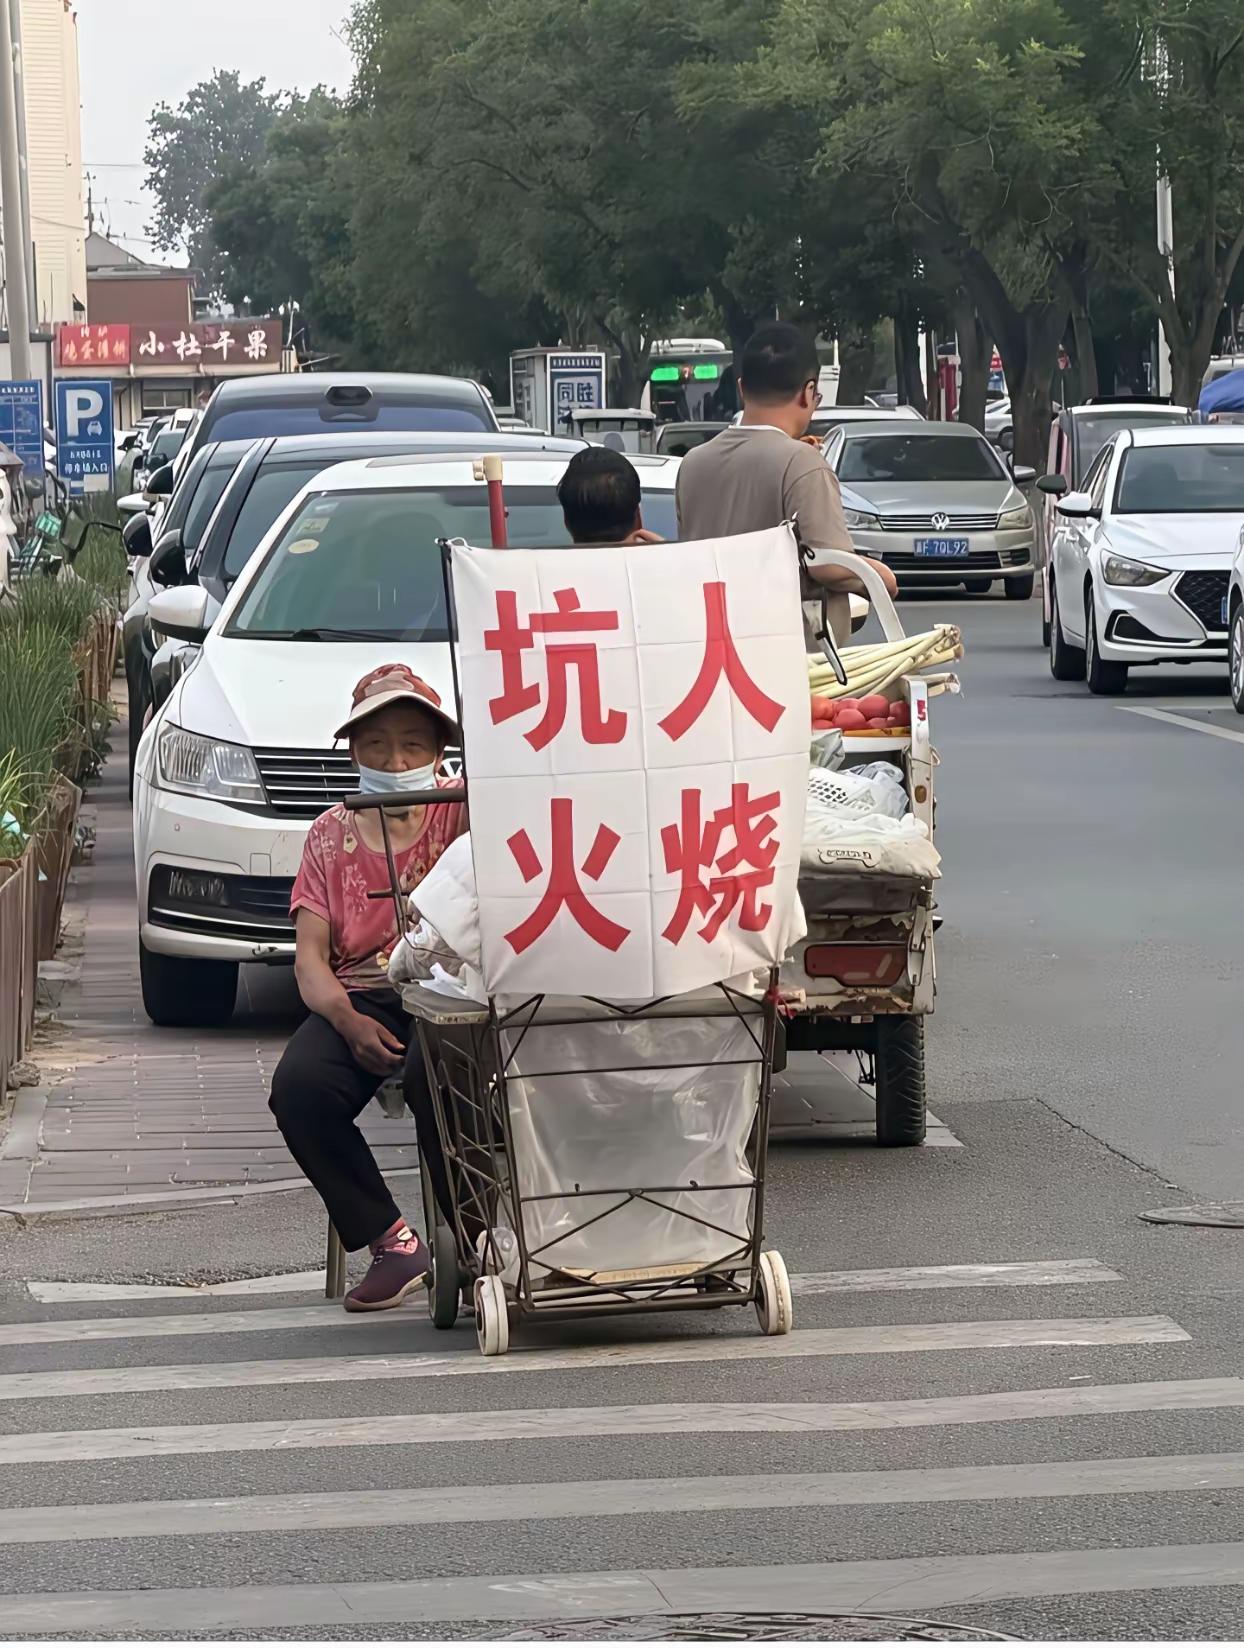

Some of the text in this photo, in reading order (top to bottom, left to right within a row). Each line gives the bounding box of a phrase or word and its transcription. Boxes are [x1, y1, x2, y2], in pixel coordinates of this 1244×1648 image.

[139, 330, 268, 361] 小杜干果
[65, 389, 103, 437] P
[483, 581, 786, 752] 坑人
[503, 782, 781, 956] 火烧
